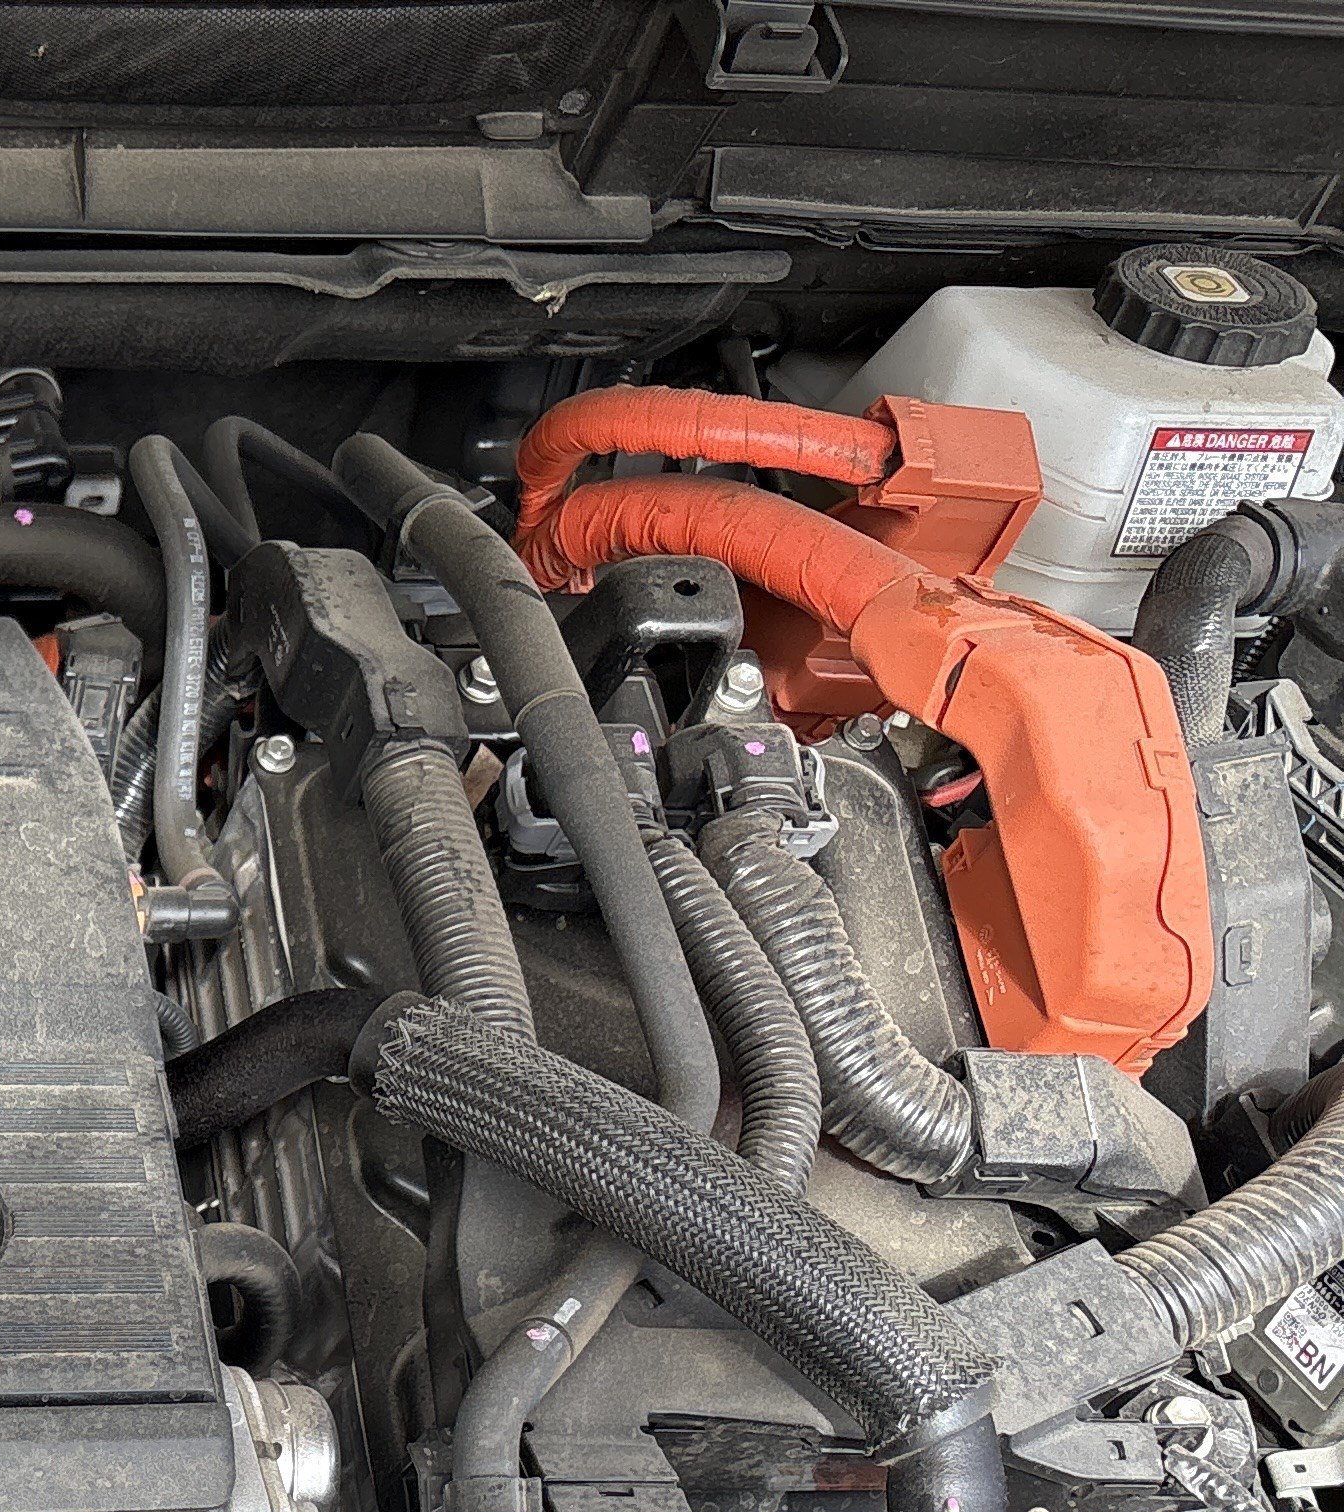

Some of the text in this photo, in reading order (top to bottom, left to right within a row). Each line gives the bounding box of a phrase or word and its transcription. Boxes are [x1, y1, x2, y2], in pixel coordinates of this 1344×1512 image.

[1206, 434, 1268, 448] DANGER
[1297, 1290, 1327, 1320] DENSO
[1296, 1339, 1335, 1384] BN
